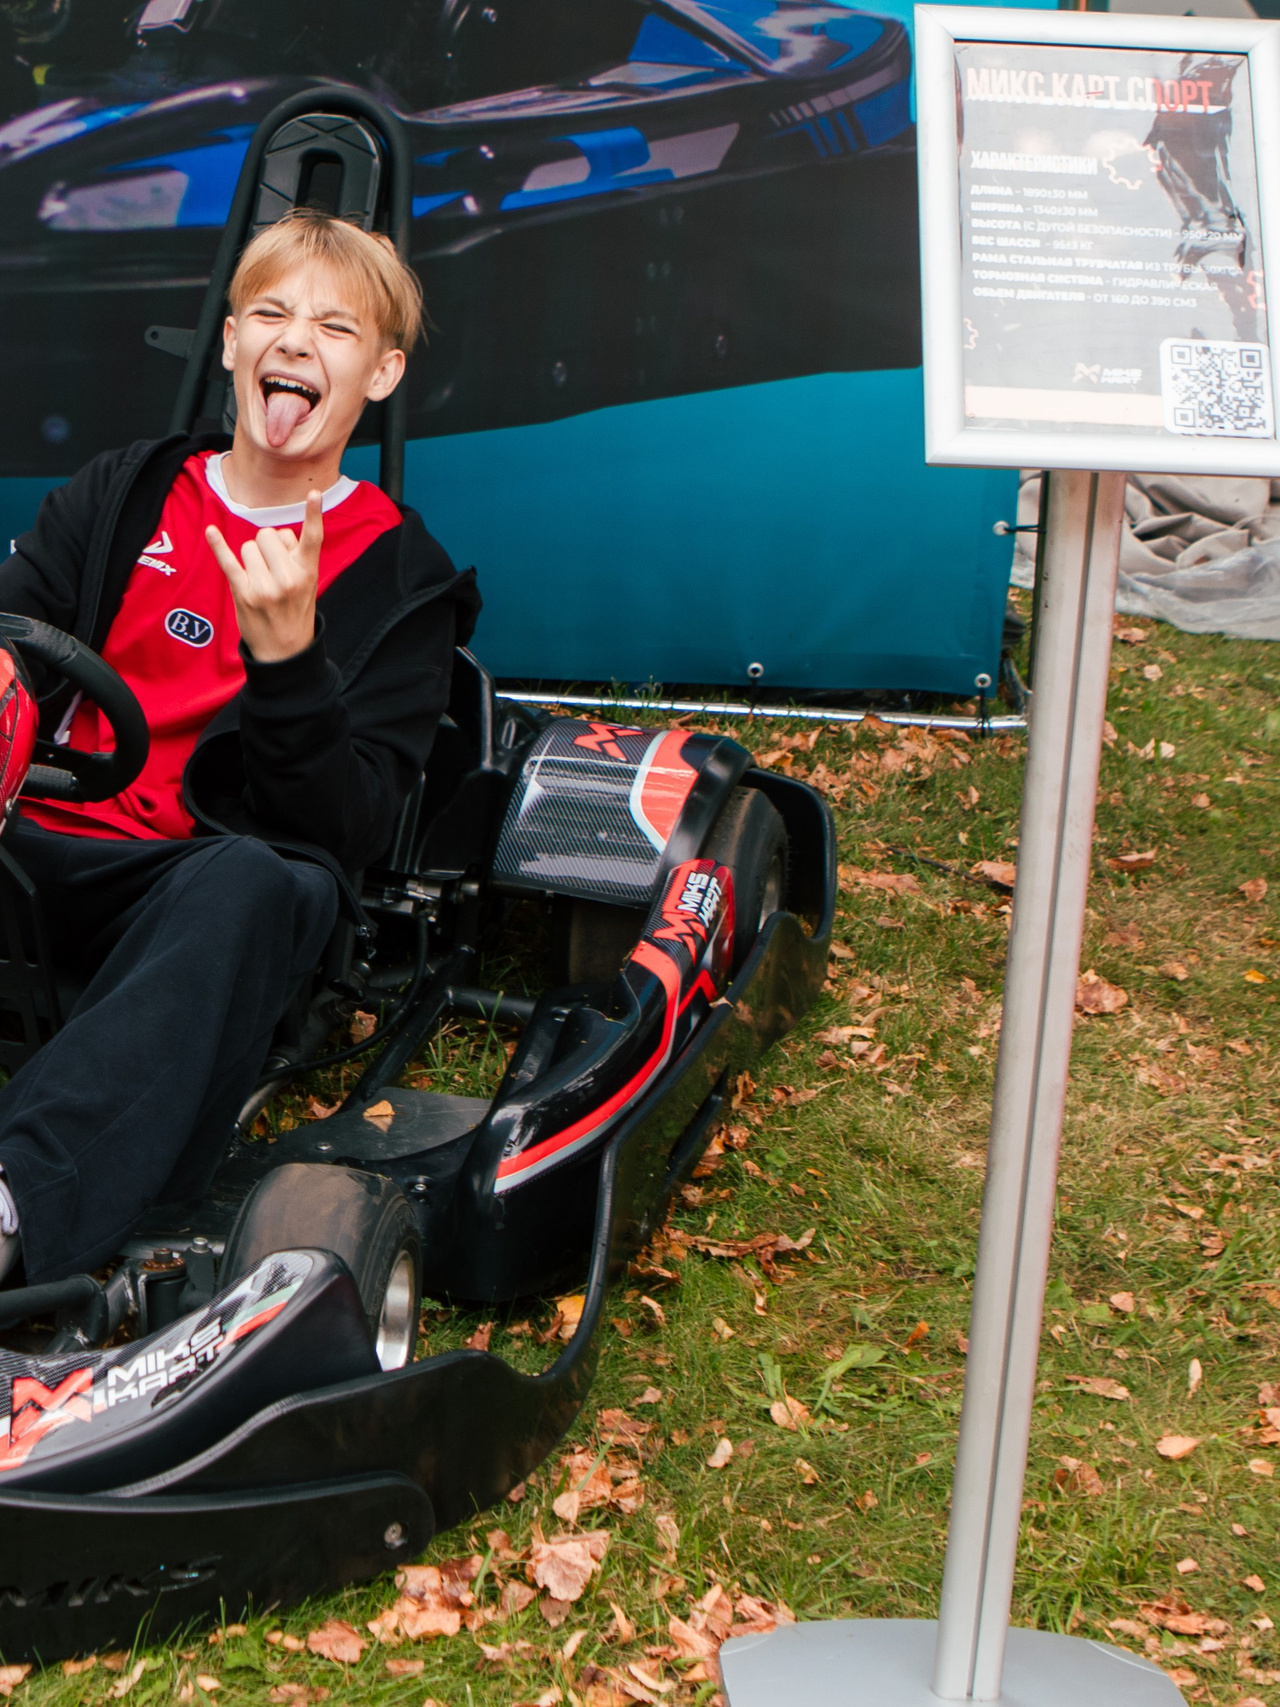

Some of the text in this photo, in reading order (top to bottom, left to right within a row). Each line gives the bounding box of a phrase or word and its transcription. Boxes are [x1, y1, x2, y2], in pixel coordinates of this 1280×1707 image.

[966, 67, 1213, 113] МИКС КАРТ СПОРТ
[970, 150, 1098, 175] ХАРАКТЕРИСТИКИ
[970, 184, 1014, 196] ДЛИНА
[970, 201, 1024, 214] ШИРИНА
[971, 218, 1022, 231] ВЫСОТА
[972, 252, 1008, 264] РАМА
[676, 871, 711, 914] MIKS
[697, 876, 723, 929] KART
[107, 1315, 222, 1388] MIKS
[106, 1334, 225, 1408] KART
